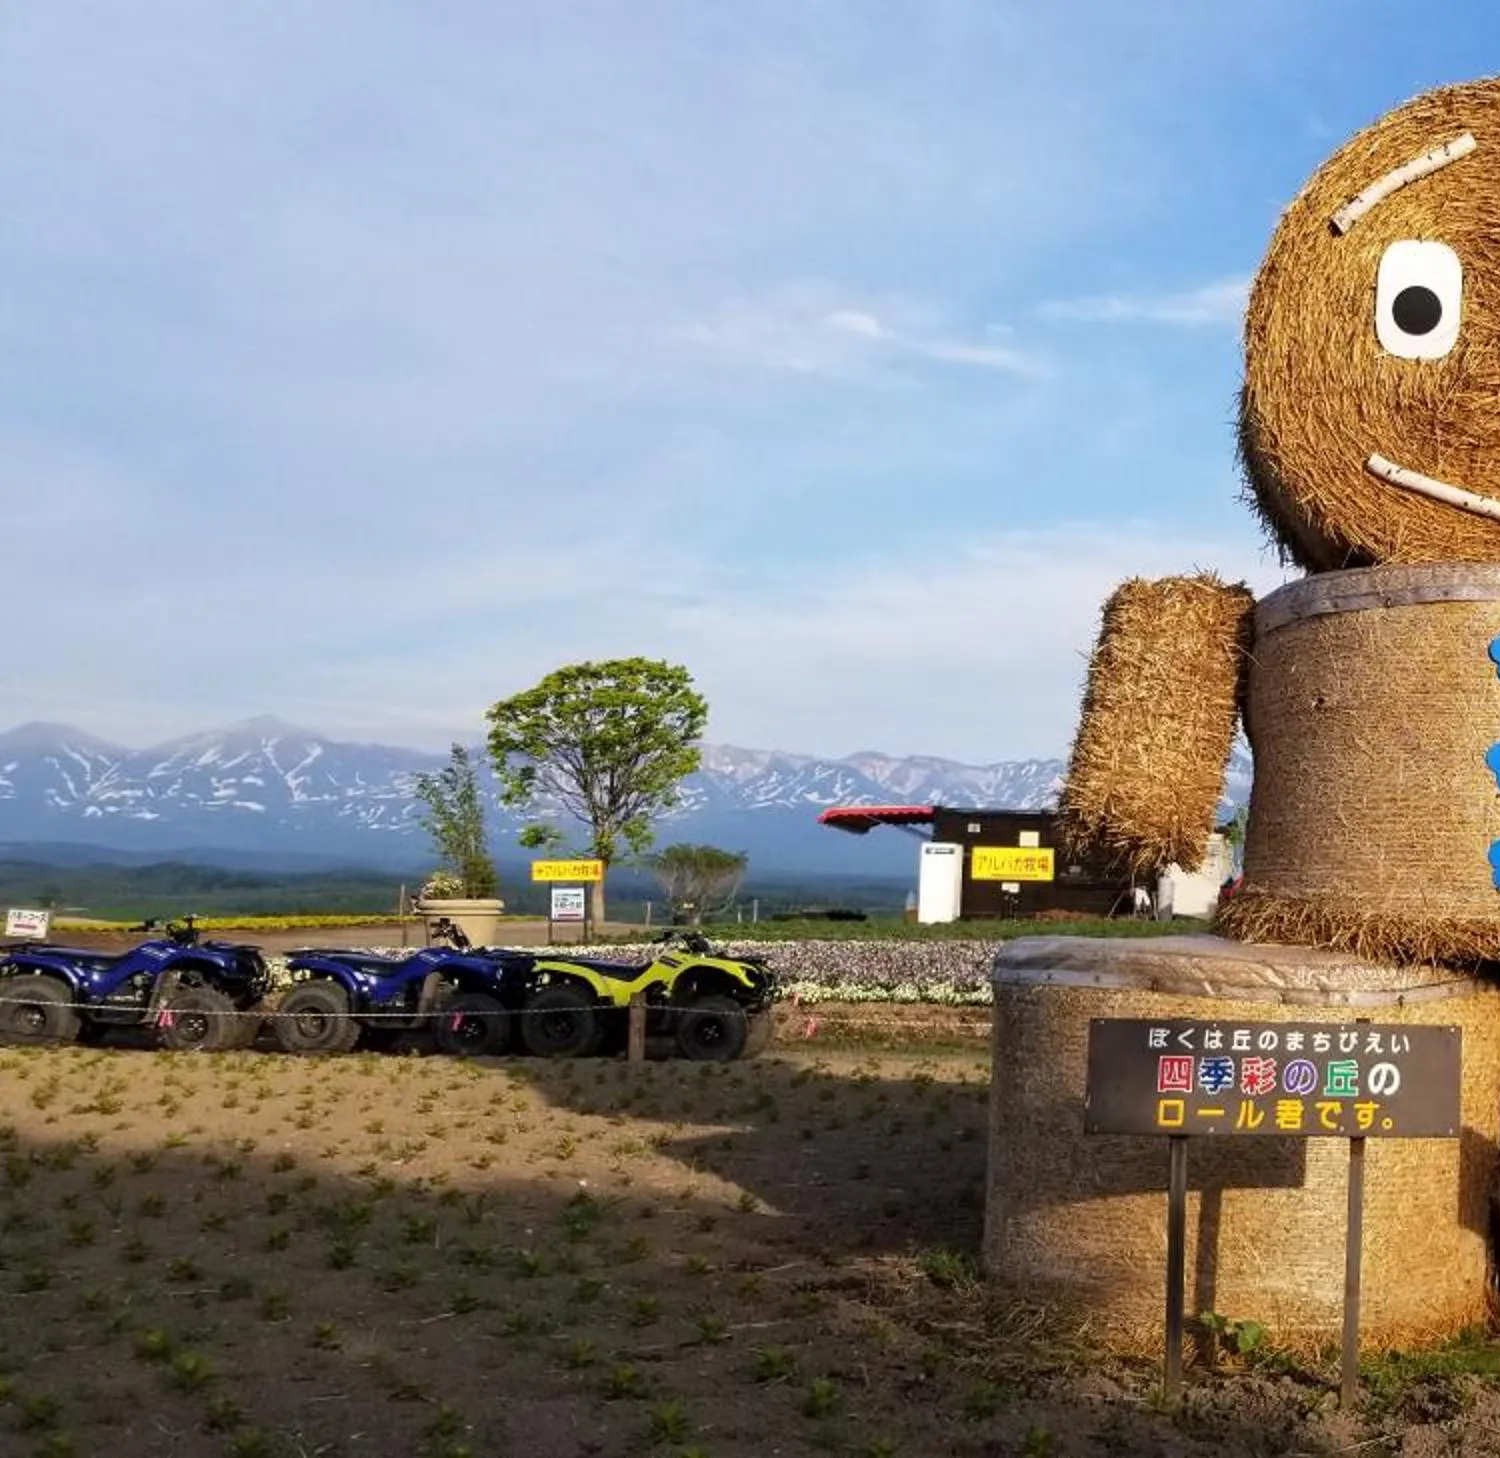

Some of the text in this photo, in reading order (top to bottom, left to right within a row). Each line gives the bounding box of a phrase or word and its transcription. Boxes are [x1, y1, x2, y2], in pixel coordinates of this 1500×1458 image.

[1149, 1027, 1410, 1054] ぼくは丘のまちびえい
[1157, 1055, 1400, 1096] 四季彩の丘の
[1157, 1099, 1394, 1129] ロール君です。
